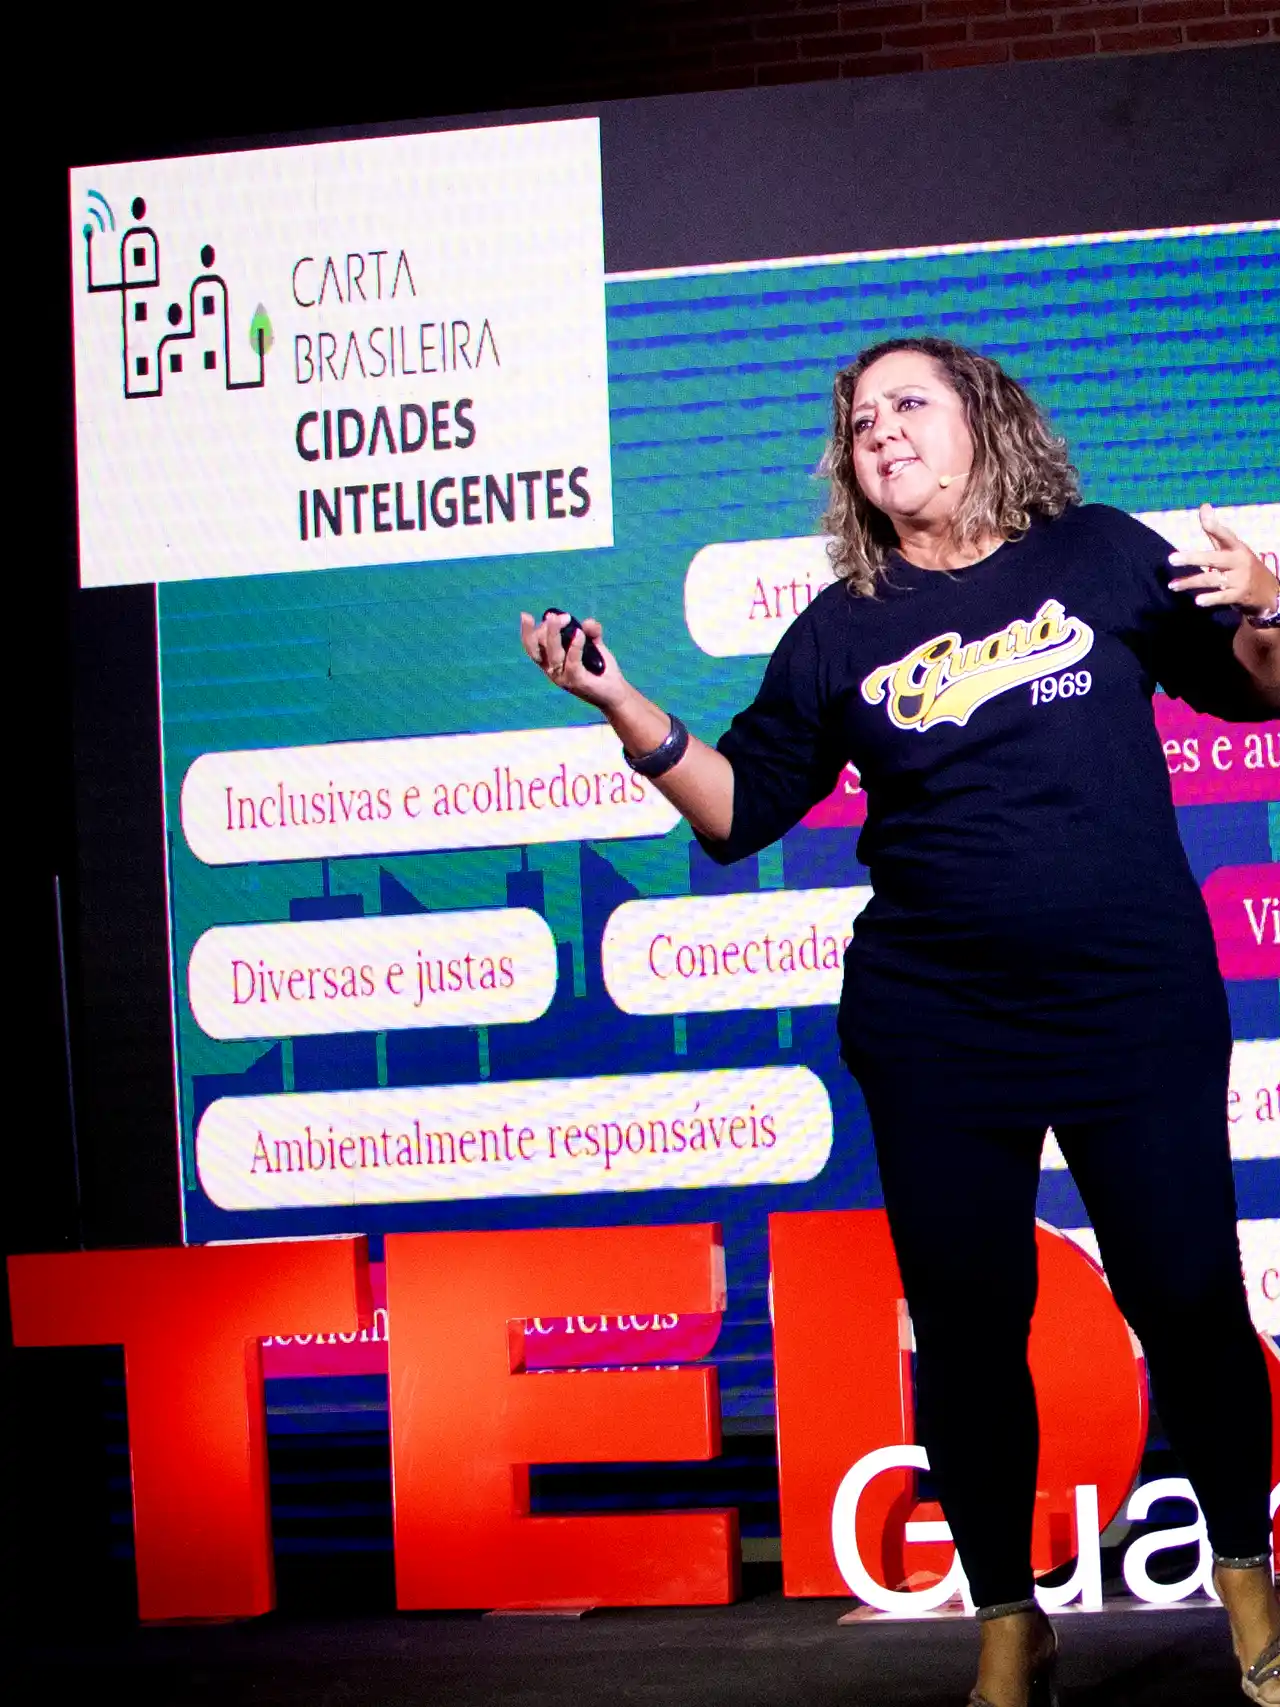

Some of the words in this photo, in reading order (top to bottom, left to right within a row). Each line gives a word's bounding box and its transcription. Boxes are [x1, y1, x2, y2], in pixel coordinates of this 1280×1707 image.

[292, 249, 417, 307] CARTA
[294, 318, 501, 384] BRASILEIRA
[295, 398, 476, 461] CIDADES
[299, 466, 591, 540] INTELIGENTES
[861, 598, 1094, 732] Guará
[1031, 670, 1092, 706] 1969
[1211, 735, 1233, 771] e
[225, 774, 393, 830] Inclusivas
[404, 783, 422, 817] e
[433, 760, 646, 817] acolhedoras
[231, 952, 375, 1005] Diversas
[386, 960, 405, 993] e
[414, 948, 515, 1007] justas
[250, 1119, 535, 1175] Ambientalmente
[547, 1100, 777, 1170] responsáveis
